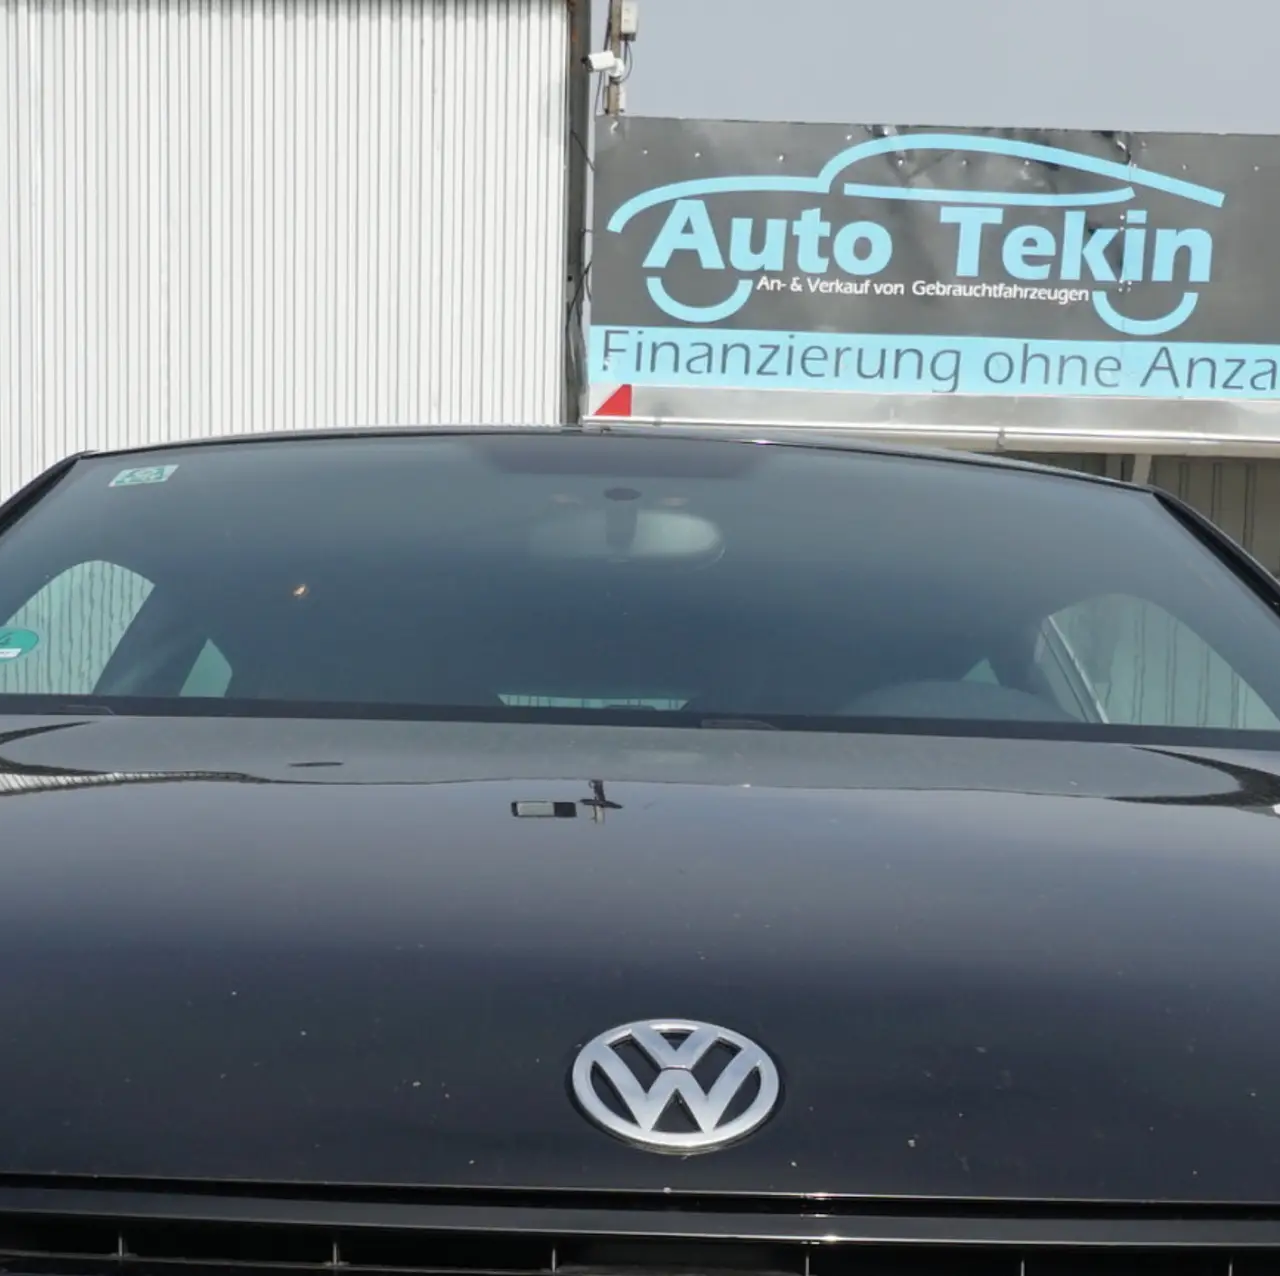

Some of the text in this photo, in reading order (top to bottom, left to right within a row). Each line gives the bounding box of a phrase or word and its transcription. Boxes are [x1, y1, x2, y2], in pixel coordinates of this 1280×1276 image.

[642, 199, 1214, 283] Auto Tekin
[756, 276, 1090, 304] An- & Verkauf von Gebrauchtfahrzeugen
[602, 329, 961, 393] Finanzierung
[983, 347, 1122, 389] ohne
